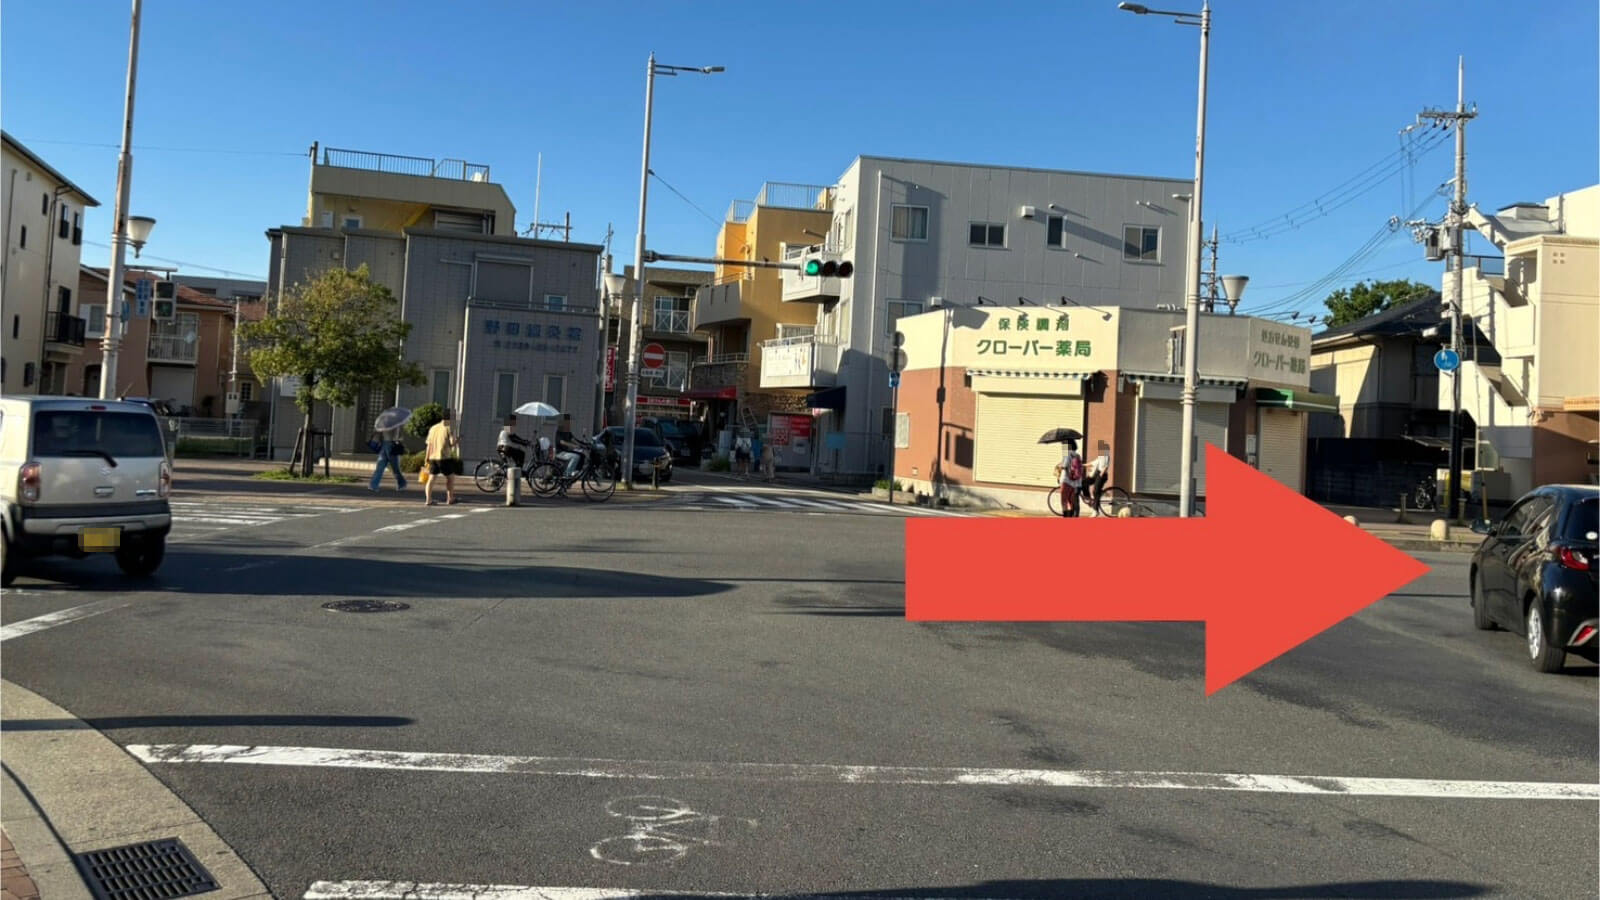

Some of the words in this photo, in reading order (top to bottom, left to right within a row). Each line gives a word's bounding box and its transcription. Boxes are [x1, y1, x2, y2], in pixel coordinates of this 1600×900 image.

[998, 316, 1070, 332] 保険調剤
[976, 339, 1092, 357] クローバー薬局
[1253, 350, 1307, 375] クローバー薬局
